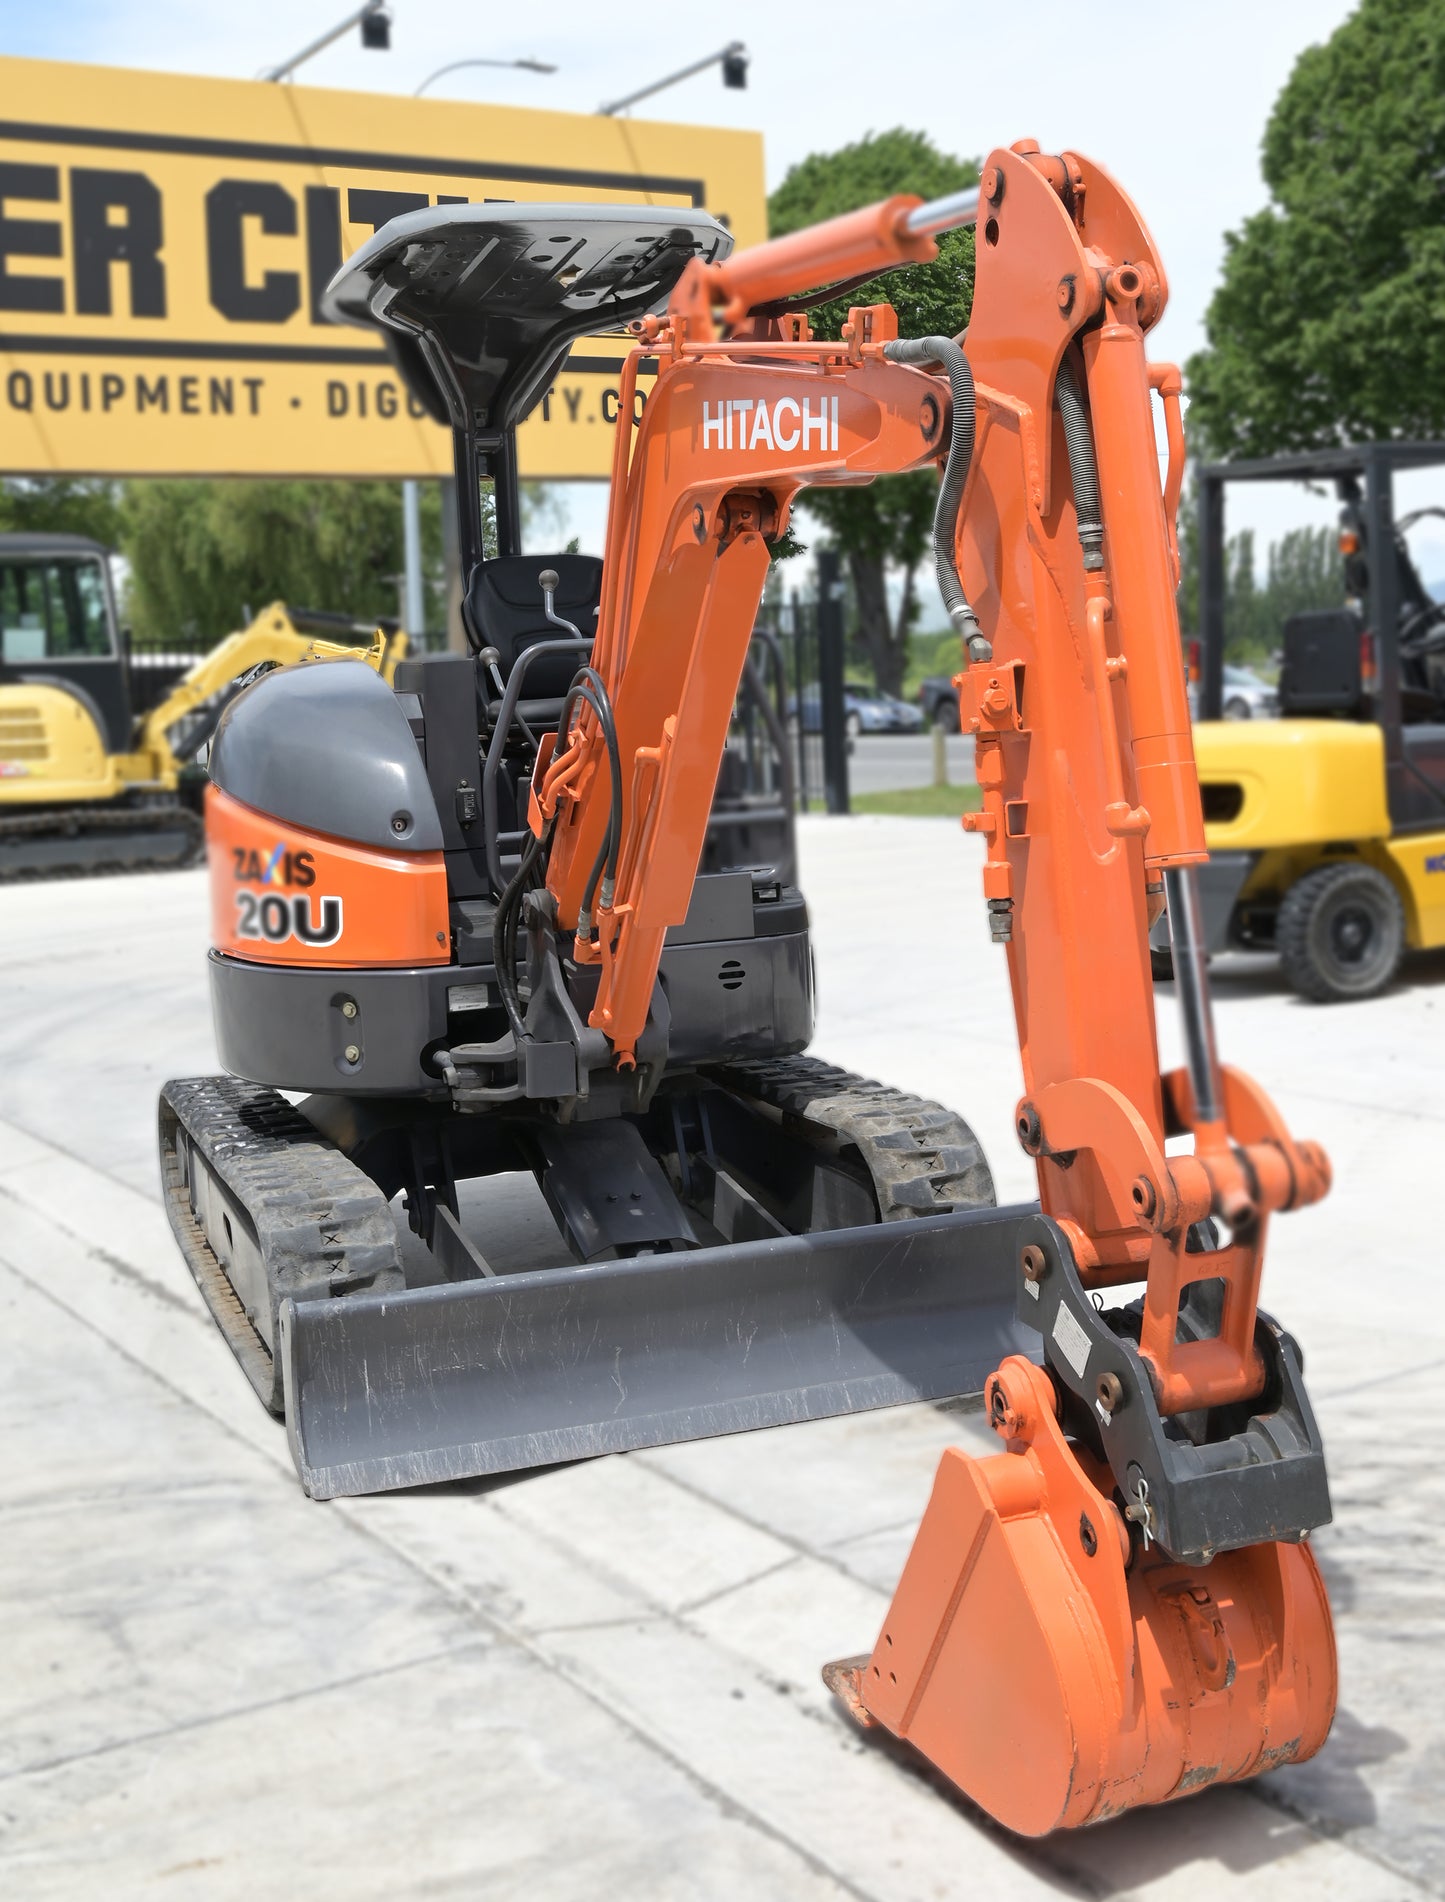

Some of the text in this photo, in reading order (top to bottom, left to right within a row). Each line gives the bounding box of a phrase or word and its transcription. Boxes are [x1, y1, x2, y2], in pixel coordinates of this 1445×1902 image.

[0, 161, 167, 319] ER
[7, 369, 265, 416] QUIPMENT
[703, 395, 839, 452] HITACHI
[234, 842, 316, 888] ZAXIS
[236, 890, 343, 947] 20U
